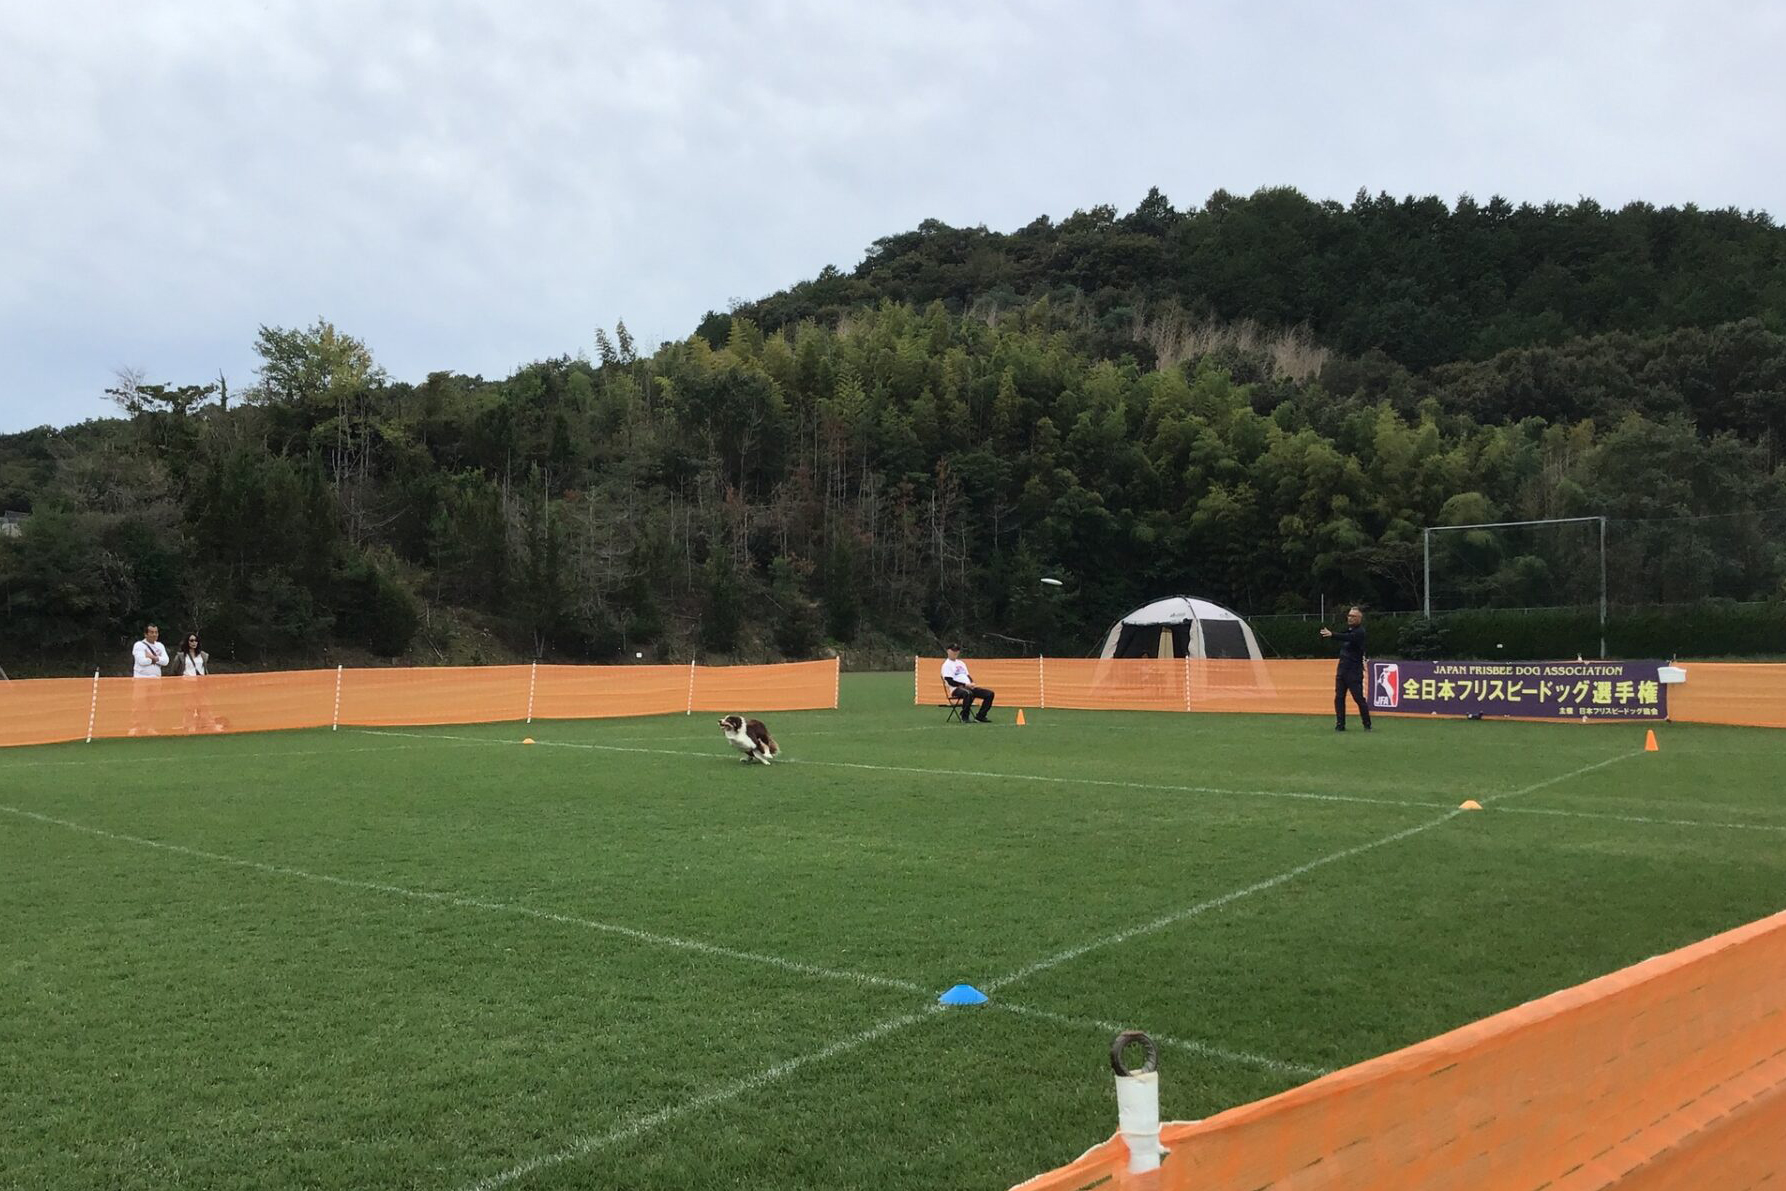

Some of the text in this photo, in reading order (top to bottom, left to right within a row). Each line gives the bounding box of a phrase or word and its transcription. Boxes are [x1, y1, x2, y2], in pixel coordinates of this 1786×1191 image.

[1433, 665, 1467, 675] JAPAN
[1515, 666, 1541, 676] DOG
[1543, 666, 1623, 676] ASSOCIATION
[1403, 678, 1658, 704] 全日本フリスビードッグ選手権
[1375, 695, 1389, 705] JFA
